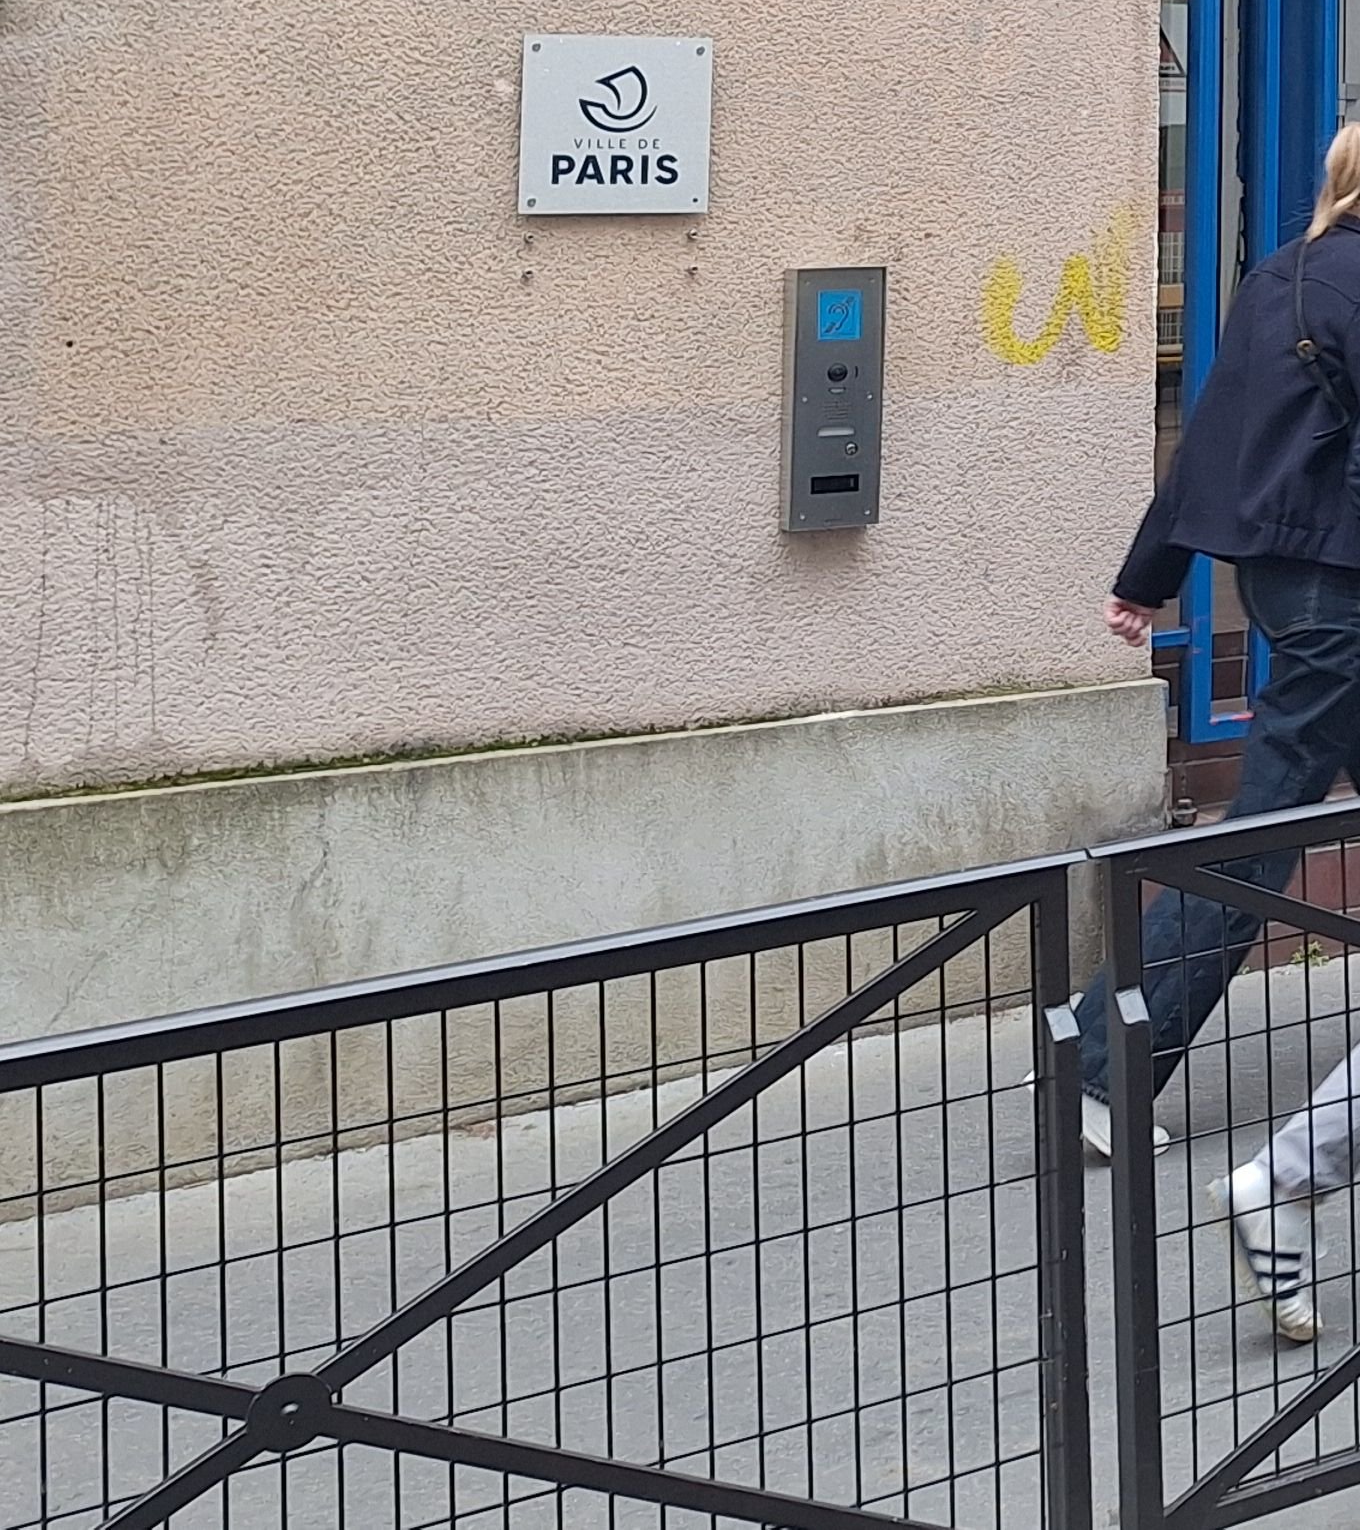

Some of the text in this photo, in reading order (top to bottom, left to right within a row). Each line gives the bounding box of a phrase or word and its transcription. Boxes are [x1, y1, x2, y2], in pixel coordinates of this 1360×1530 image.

[573, 138, 661, 150] VILLE DE
[550, 154, 680, 186] PARIS
